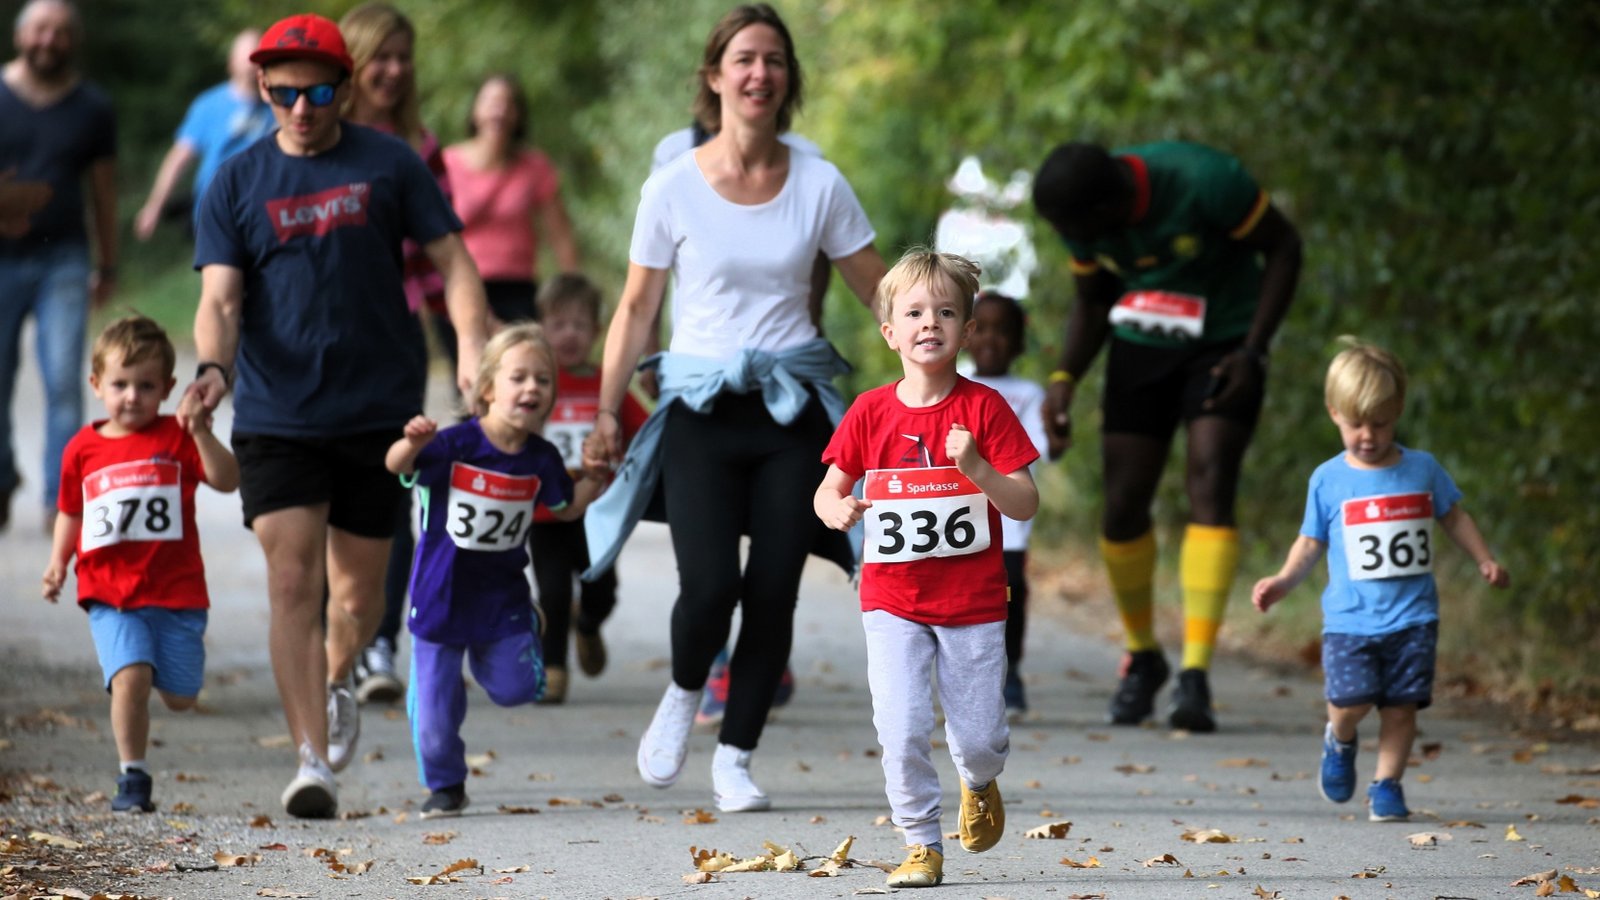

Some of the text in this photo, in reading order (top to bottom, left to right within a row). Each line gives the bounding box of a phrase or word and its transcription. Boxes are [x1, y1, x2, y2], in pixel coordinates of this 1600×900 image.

[906, 481, 959, 495] Sparkasse
[93, 496, 171, 538] 378
[454, 502, 526, 544] 324
[877, 505, 976, 555] 336
[1359, 528, 1431, 572] 363
